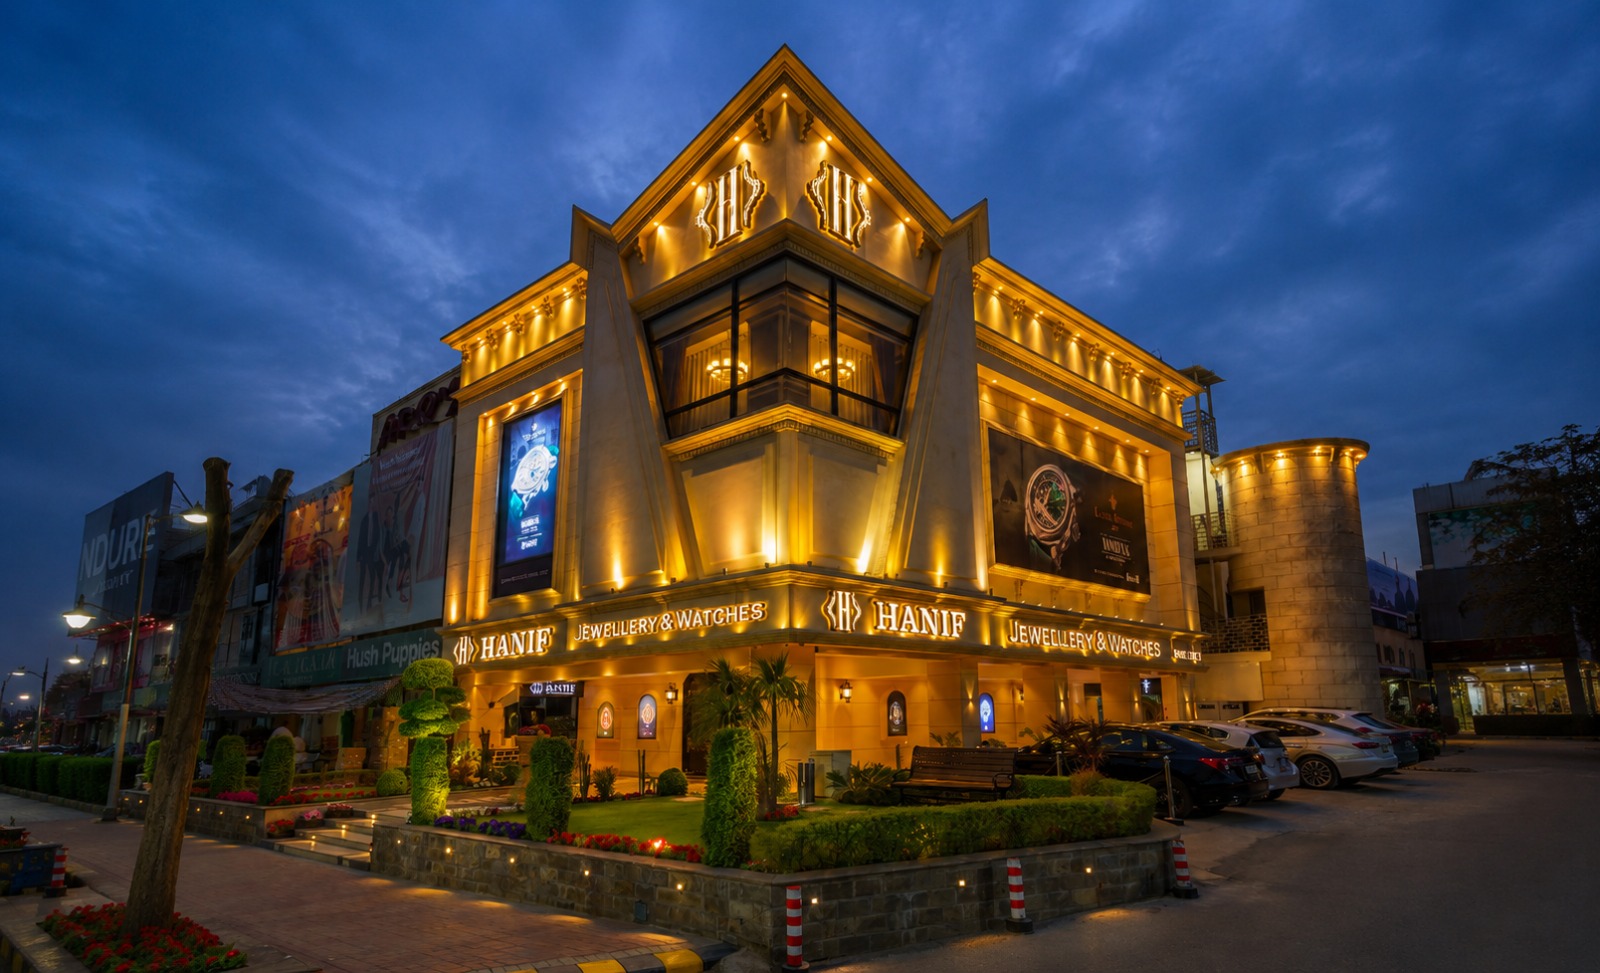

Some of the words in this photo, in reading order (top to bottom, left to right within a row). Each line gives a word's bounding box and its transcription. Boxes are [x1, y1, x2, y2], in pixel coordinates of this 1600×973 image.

[79, 508, 159, 581] NDURE
[574, 617, 658, 641] JEWELLERY
[660, 613, 673, 631] &
[676, 603, 764, 629] WATCHES
[875, 601, 966, 638] HANIF
[346, 644, 379, 669] Hush
[382, 637, 440, 668] Puppies
[480, 627, 552, 660] HANIF
[1096, 631, 1106, 651] &
[1108, 633, 1161, 658] WATCHES
